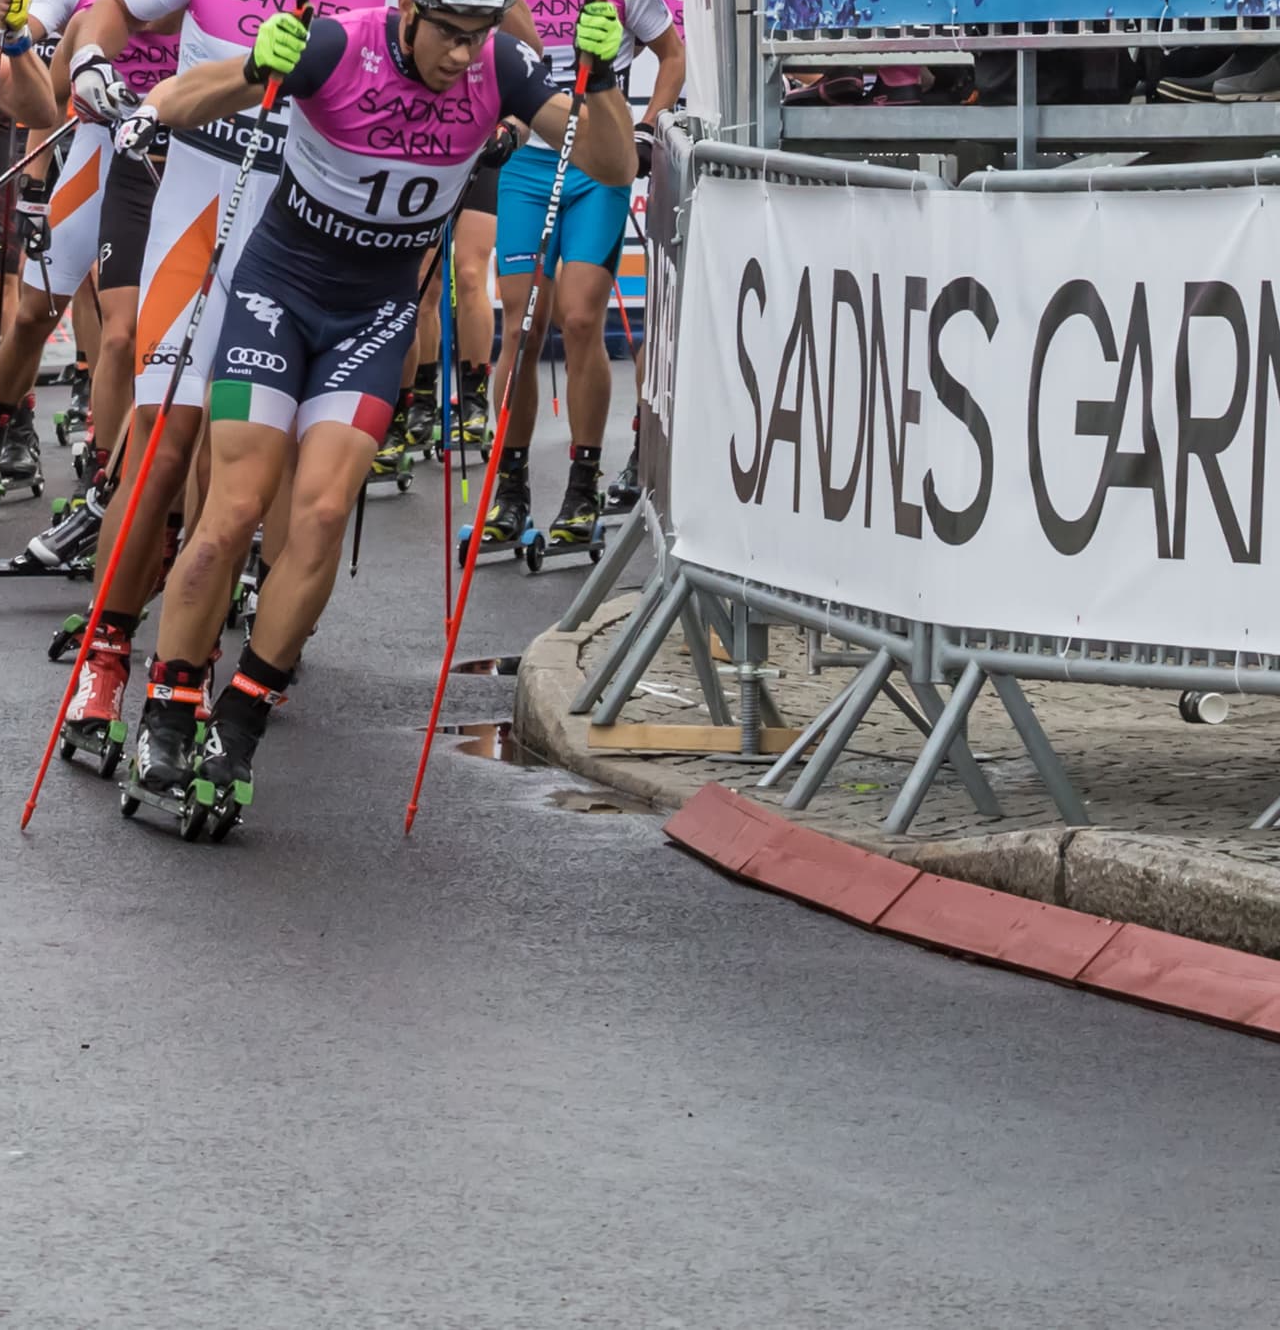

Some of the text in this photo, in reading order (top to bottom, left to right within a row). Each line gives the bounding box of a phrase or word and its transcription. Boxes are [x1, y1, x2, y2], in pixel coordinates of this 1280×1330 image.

[358, 88, 474, 124] SANDNES
[367, 125, 451, 158] GARN
[358, 170, 439, 218] 10
[287, 184, 446, 248] Multiconsu
[226, 366, 252, 375] Audi
[730, 257, 999, 545] SANDNES
